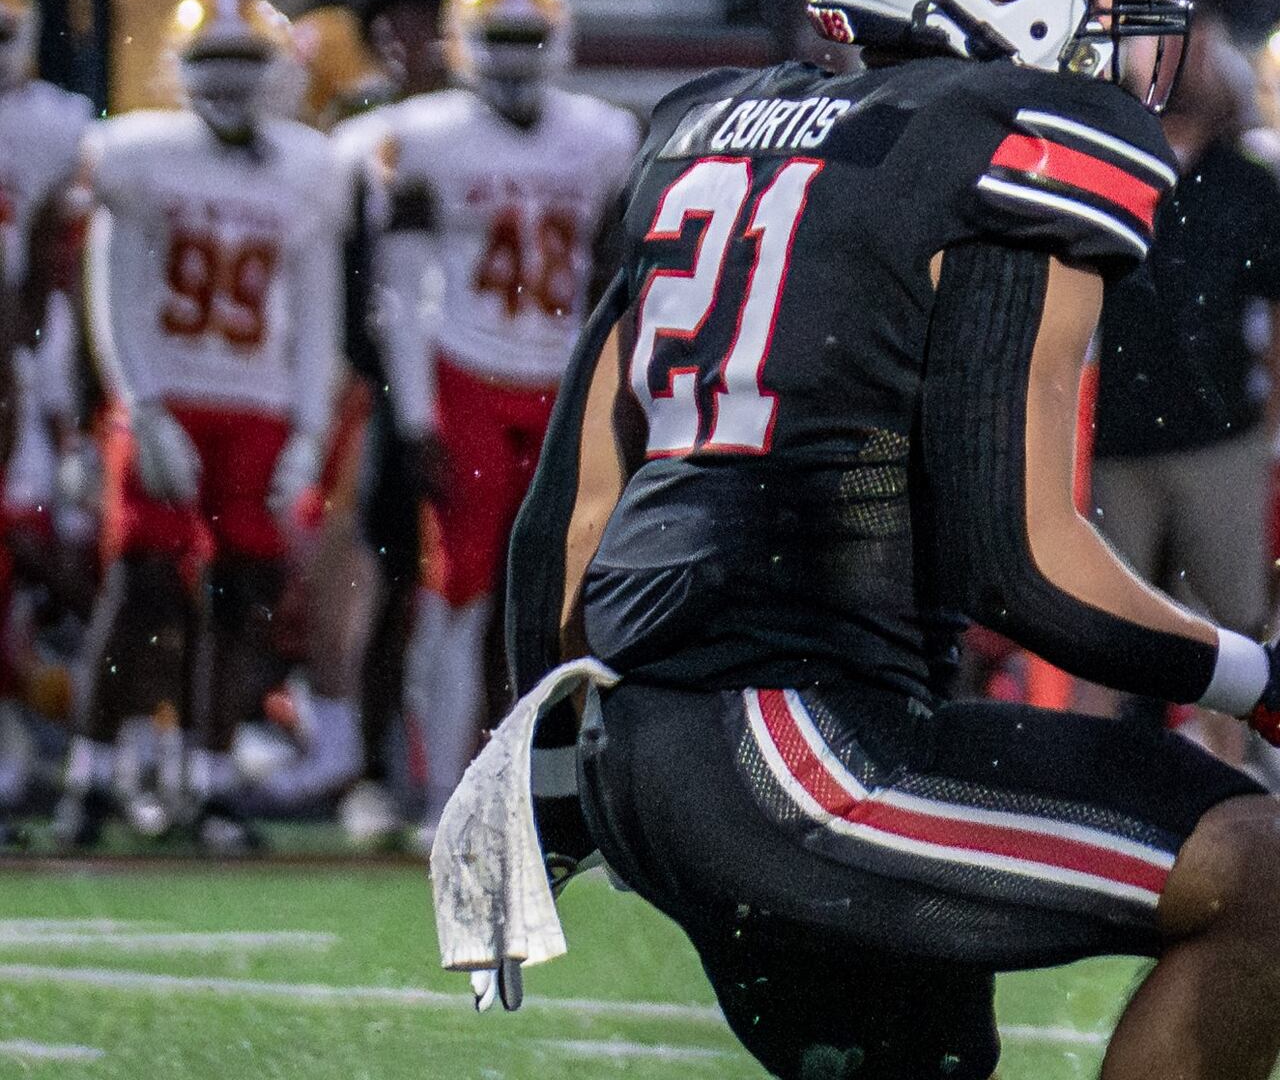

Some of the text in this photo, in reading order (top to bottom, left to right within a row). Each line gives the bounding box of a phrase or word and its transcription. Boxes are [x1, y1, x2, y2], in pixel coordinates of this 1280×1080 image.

[710, 97, 852, 151] CURTIS
[160, 223, 281, 348] 99
[628, 156, 826, 460] 21
